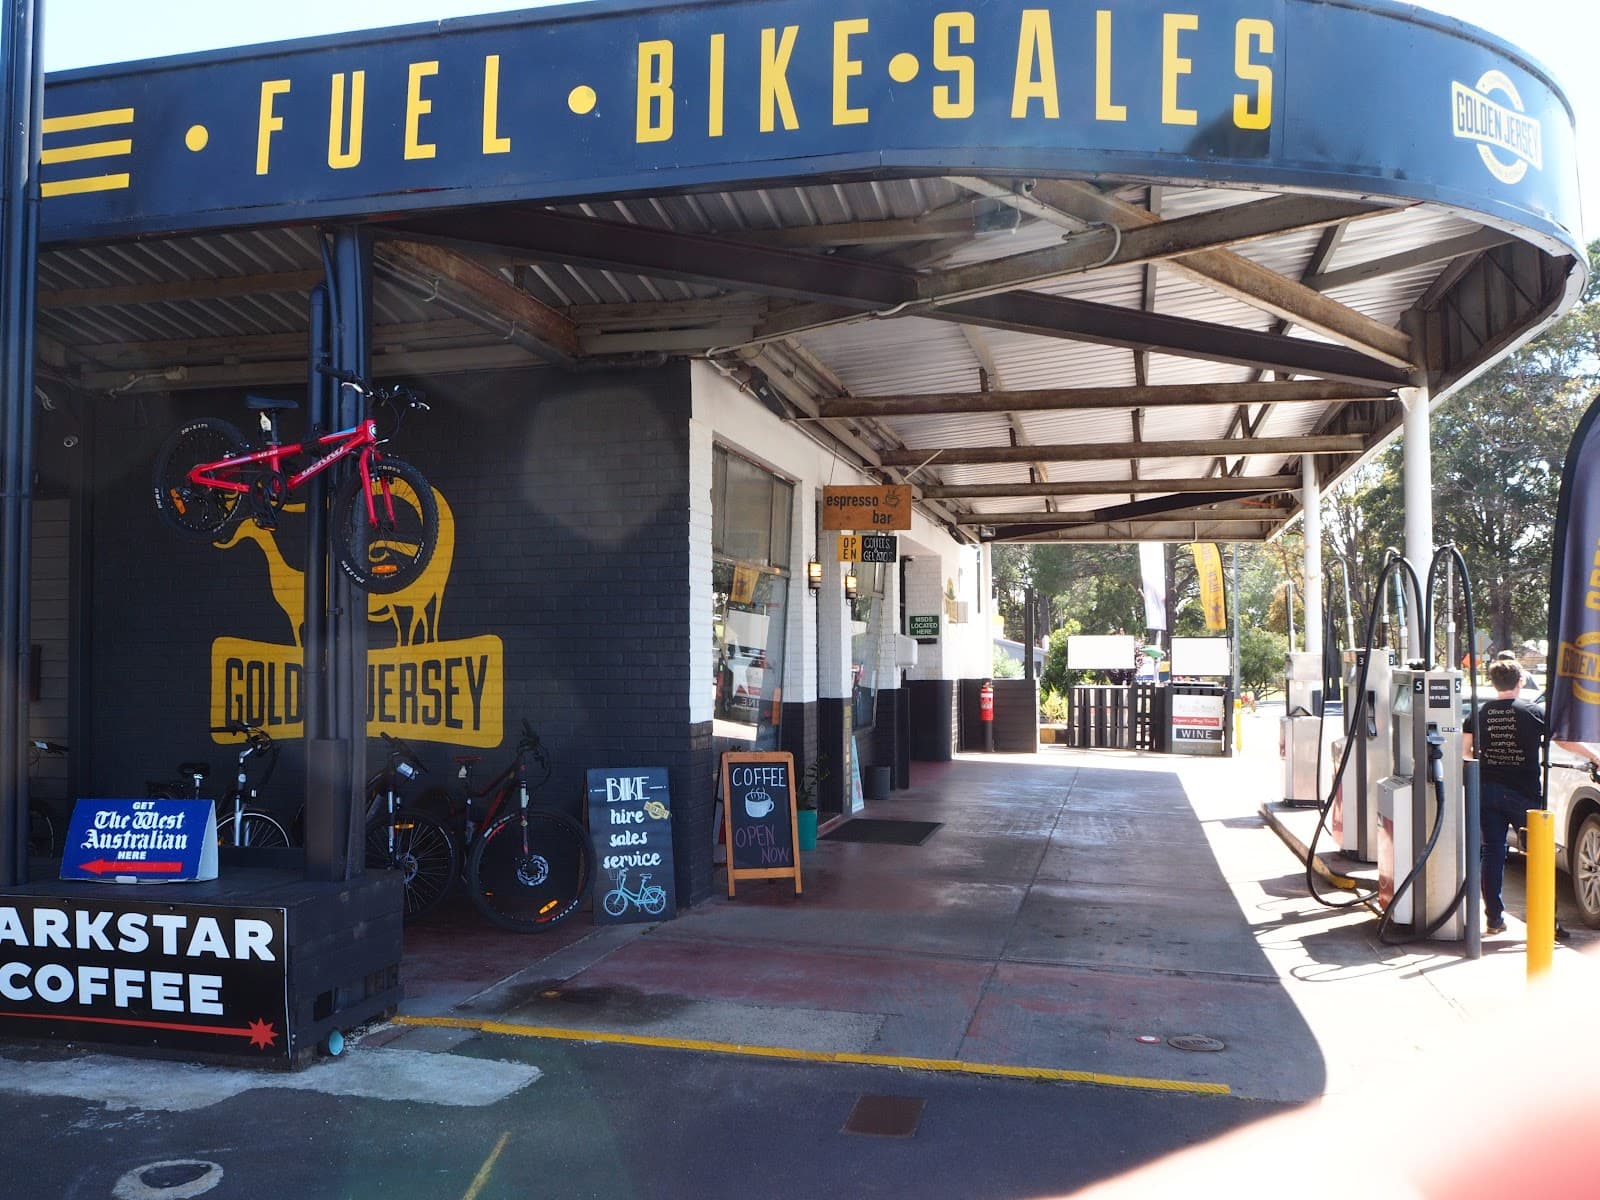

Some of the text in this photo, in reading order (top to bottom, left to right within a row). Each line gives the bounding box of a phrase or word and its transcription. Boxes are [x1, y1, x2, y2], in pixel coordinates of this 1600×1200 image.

[256, 9, 1274, 175] FUEL BIKE SALES
[1456, 91, 1503, 141] GOLDEN
[1504, 115, 1541, 163] JERSEY
[826, 496, 879, 510] espresso
[872, 509, 892, 524] bar
[1415, 681, 1423, 691] 5
[1455, 681, 1461, 690] 5
[1181, 729, 1211, 739] WINE
[732, 768, 787, 787] COFFEE
[606, 776, 650, 802] BIKE
[132, 802, 155, 810] GET
[94, 811, 185, 829] The West
[610, 809, 645, 824] hire
[80, 829, 187, 850] Australian
[609, 830, 648, 847] sales
[735, 824, 775, 848] OPEN
[117, 851, 147, 860] HERE
[603, 850, 661, 869] service
[761, 847, 789, 864] NOW
[0, 961, 224, 1016] COFFEE
